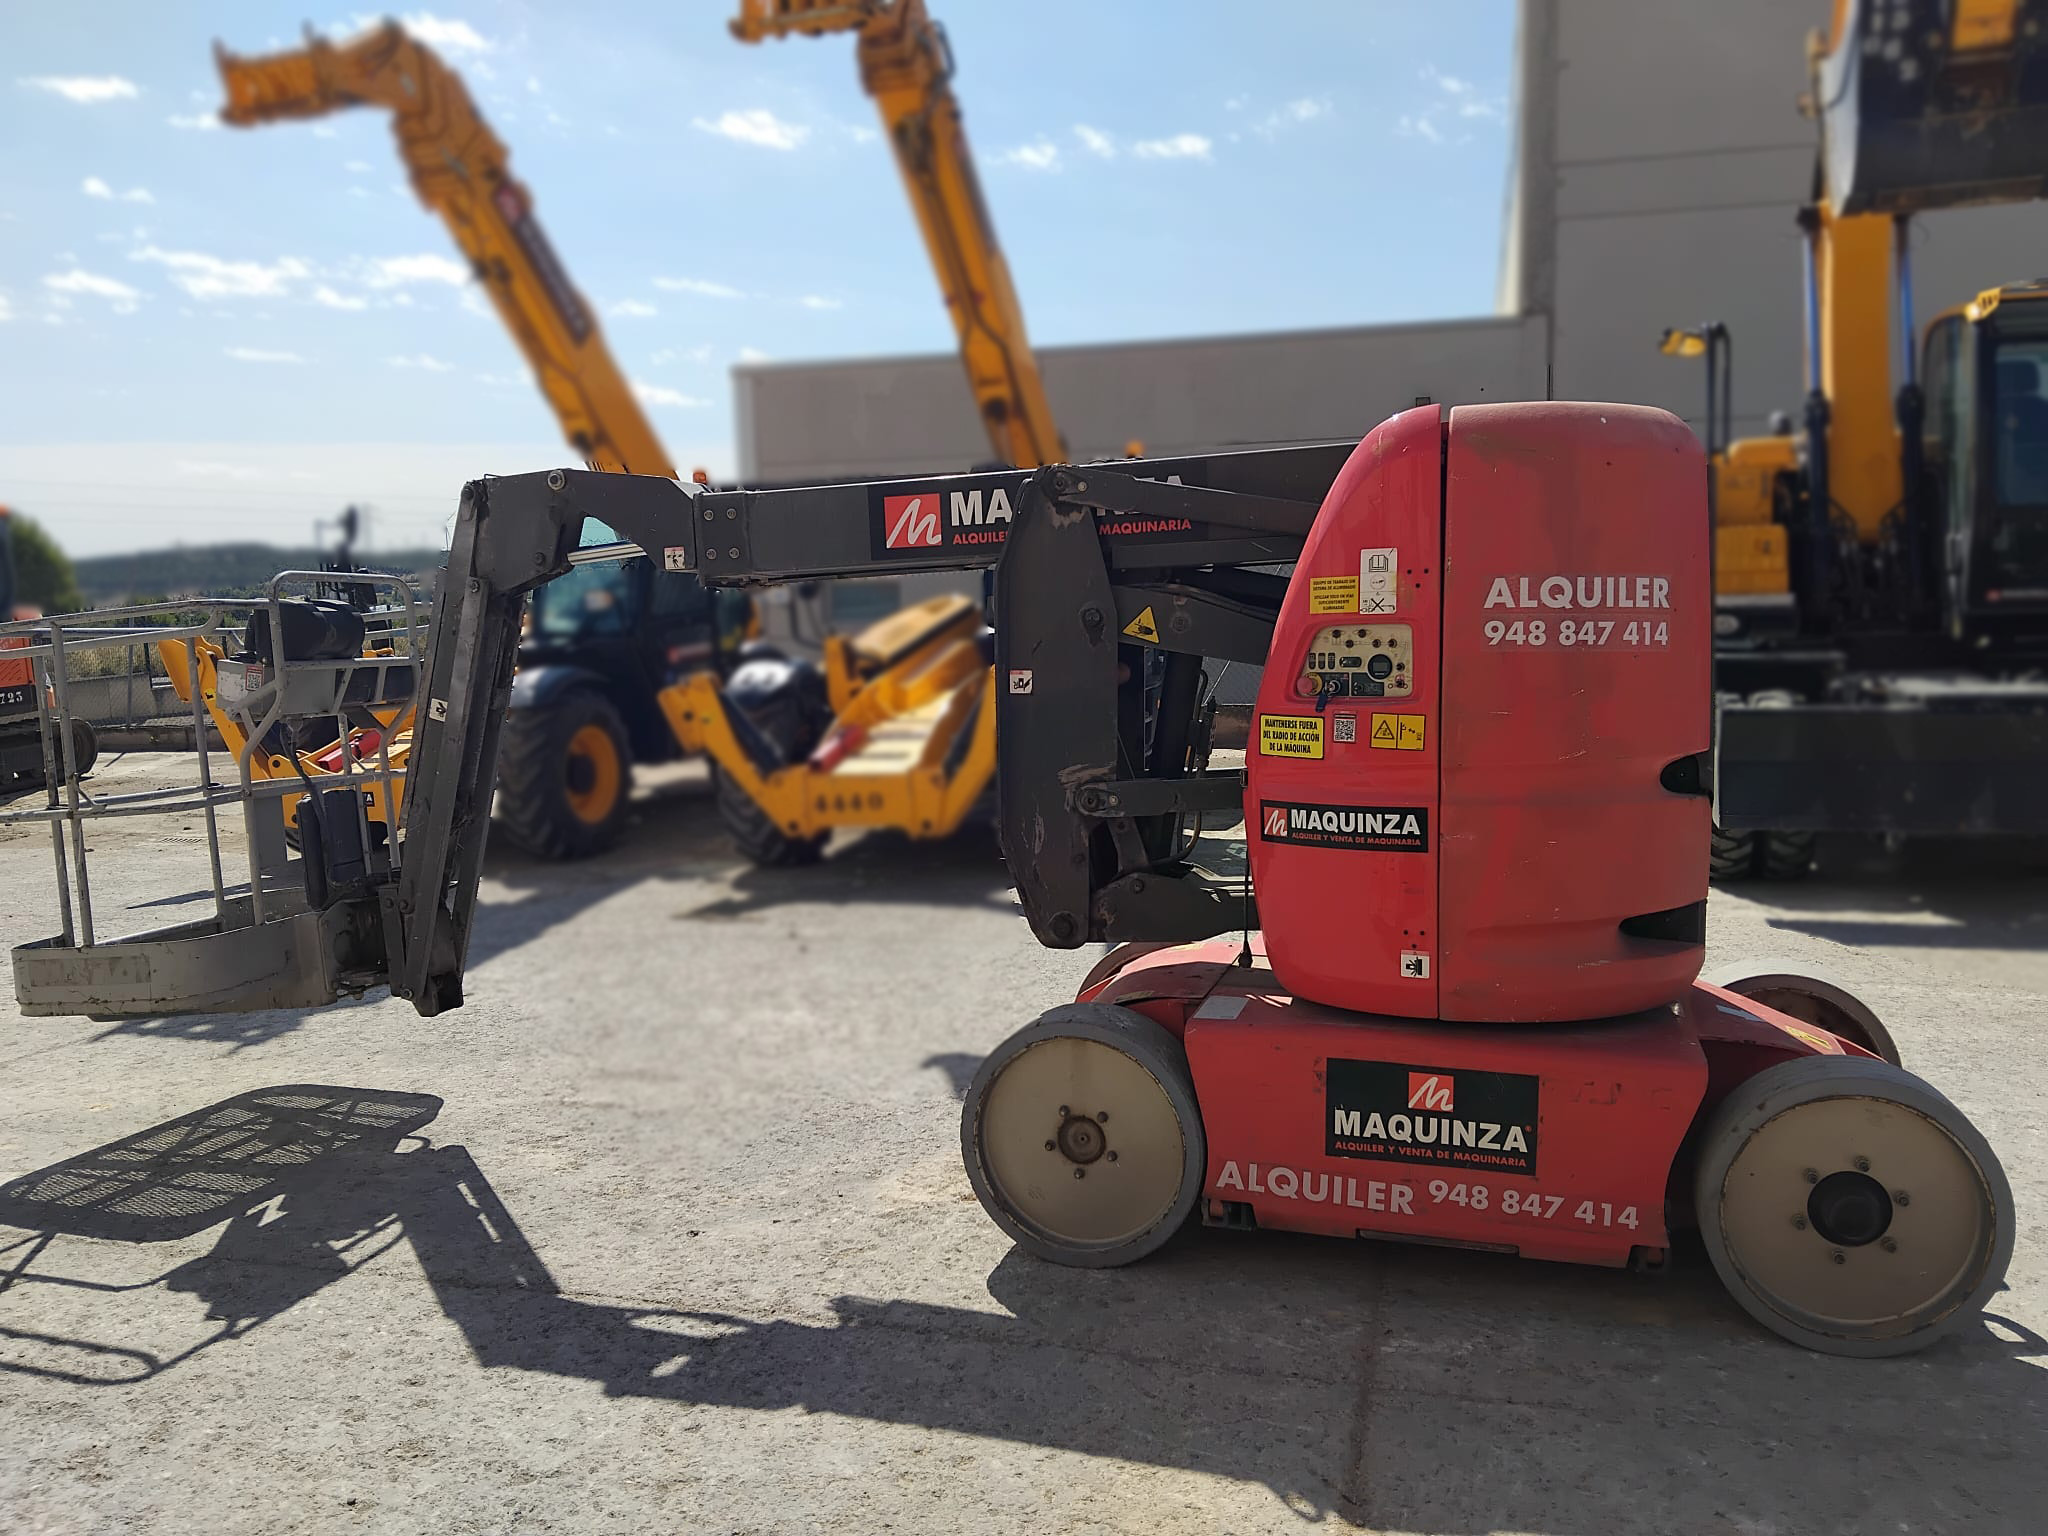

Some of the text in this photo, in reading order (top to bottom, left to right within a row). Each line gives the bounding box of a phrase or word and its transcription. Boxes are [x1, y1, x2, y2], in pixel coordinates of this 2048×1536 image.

[953, 518, 1192, 545] ALQUILE MAQUINARIA
[1483, 575, 1670, 609] ALQUILER
[1484, 620, 1669, 646] 948 847 414
[1263, 730, 1272, 739] DEL
[1272, 730, 1289, 740] RADIO
[1290, 731, 1297, 741] DE
[1265, 719, 1318, 730] MANTENERSE FUERA
[1269, 742, 1276, 751] DE
[1277, 742, 1283, 752] LA
[1290, 808, 1421, 835] MAQUINZA
[1291, 831, 1322, 842] ALQUILER
[1330, 835, 1354, 844] VENTA
[1355, 836, 1365, 844] DE
[1367, 837, 1421, 847] MAQUINARIA
[1334, 1109, 1528, 1153] MAQUINZA
[1335, 1140, 1527, 1168] ALQUILER Y VENTA DE MAQUINARIA
[1216, 1160, 1640, 1231] ALQUILER 948 847 414
